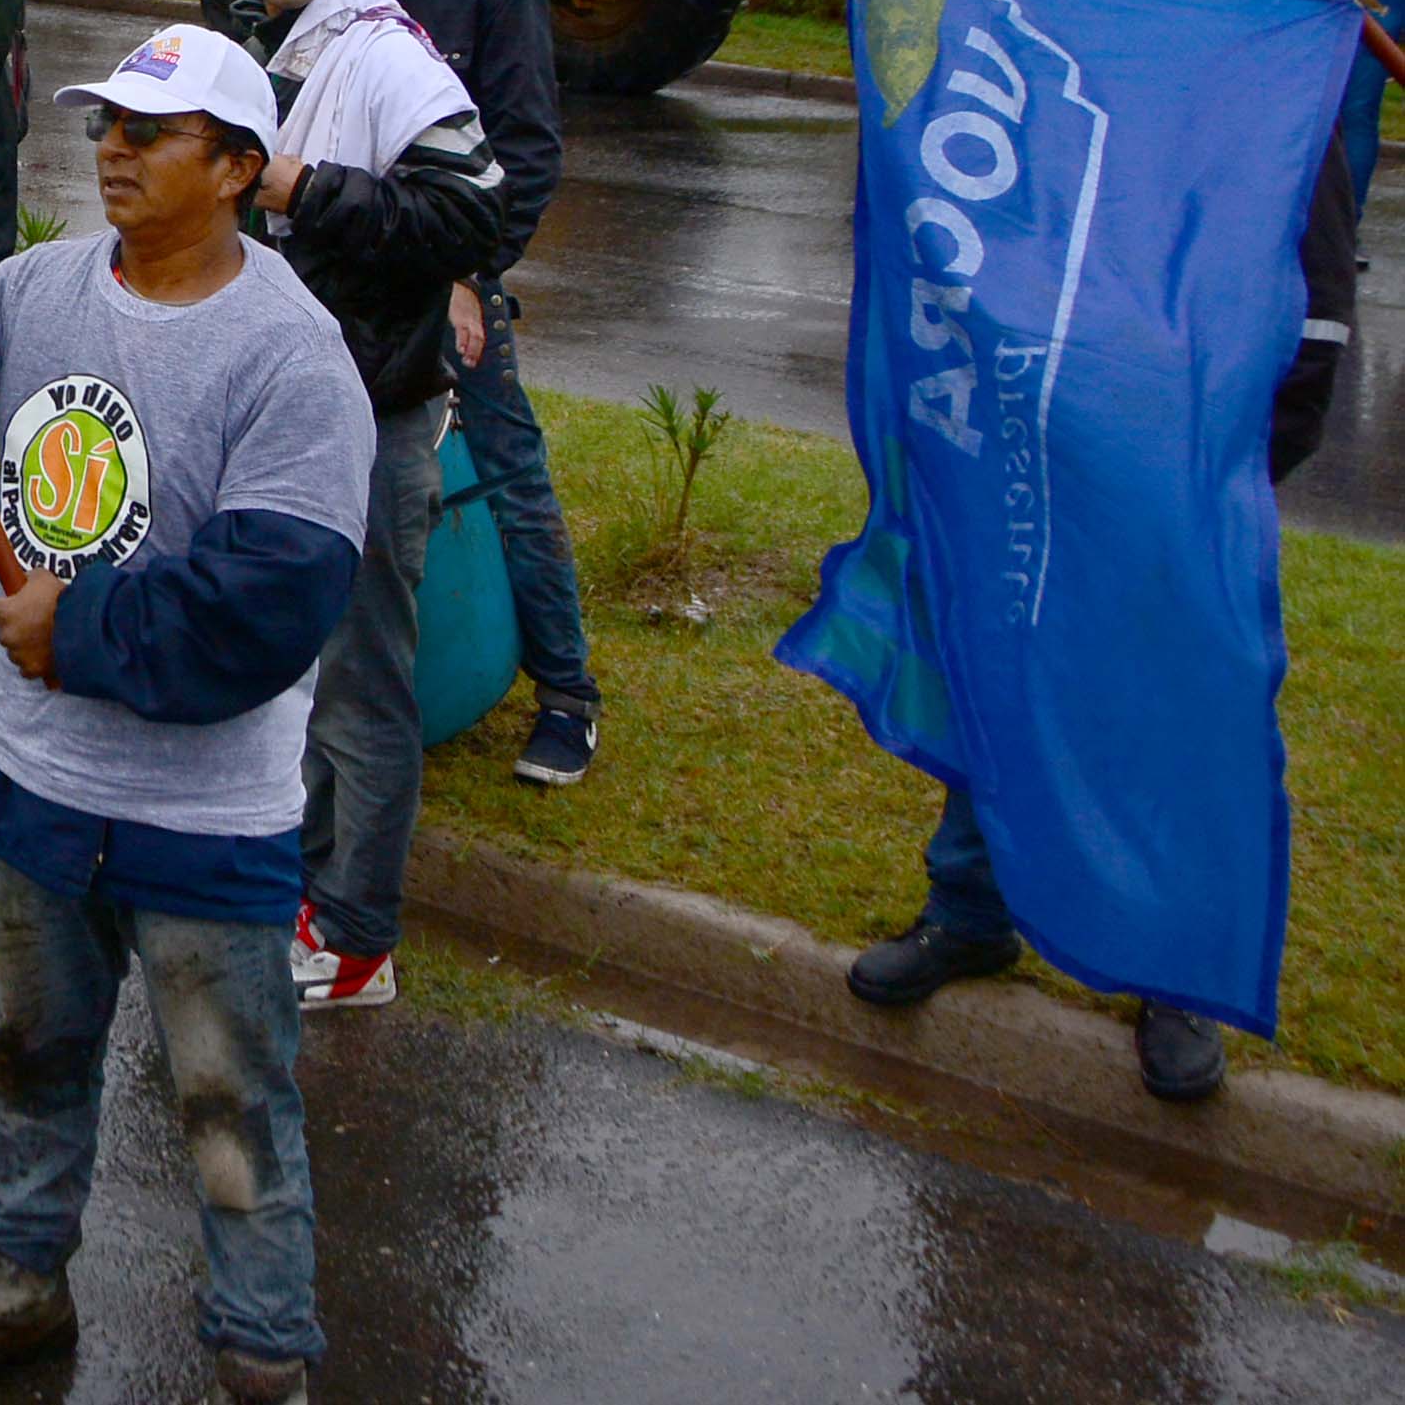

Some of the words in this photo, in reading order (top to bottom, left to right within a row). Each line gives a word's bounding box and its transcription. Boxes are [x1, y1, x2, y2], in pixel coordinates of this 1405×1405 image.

[47, 383, 76, 411] Yo
[81, 382, 133, 442] digo
[2, 459, 19, 484] al
[29, 421, 117, 534] Sí
